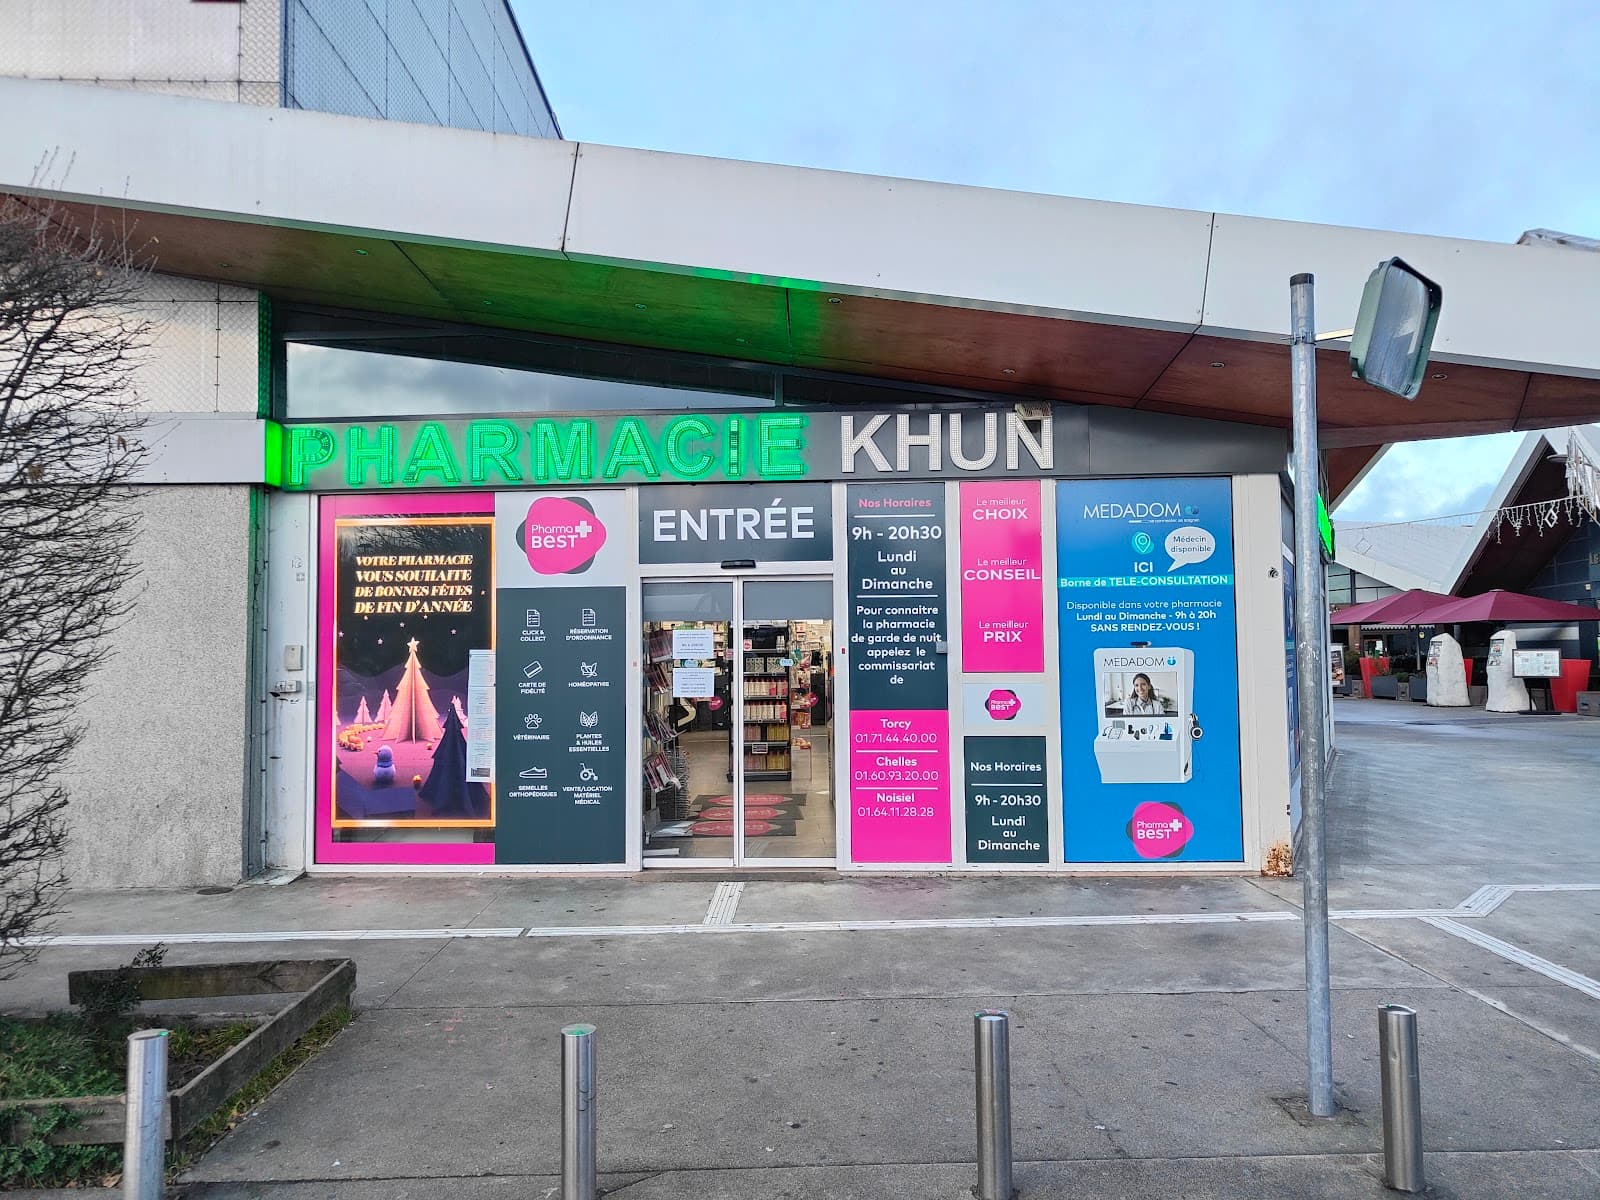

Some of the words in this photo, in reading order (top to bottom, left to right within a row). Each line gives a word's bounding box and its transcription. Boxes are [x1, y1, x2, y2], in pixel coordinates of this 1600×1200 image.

[287, 414, 806, 487] PHARMACIE
[840, 412, 1055, 474] KHUN
[858, 498, 880, 508] Nos
[884, 498, 932, 508] Horaires
[976, 497, 986, 506] Le
[988, 497, 1025, 505] meilleur
[972, 508, 1029, 521] CHOIX
[1083, 502, 1181, 519] MEDADOM
[652, 498, 815, 542] ENTRÉE
[531, 524, 574, 535] Pharma
[852, 526, 872, 540] 9h
[888, 525, 942, 540] 20h30
[1173, 535, 1207, 543] Médecin
[1170, 544, 1212, 554] disponible
[355, 555, 398, 567] VOTRE
[398, 554, 474, 566] PHARMACIE
[877, 550, 917, 562] Lundi
[977, 558, 988, 566] Le
[990, 558, 1026, 566] meilleur
[1134, 561, 1153, 573] ICI
[355, 570, 395, 583] VOUS
[395, 569, 472, 582] SOUHAITE
[890, 567, 906, 576] au
[964, 569, 1041, 581] CONSEIL
[862, 578, 933, 590] Dimanche
[1060, 577, 1092, 587] Borne
[1094, 577, 1107, 587] de
[1109, 575, 1228, 586] TELE-CONSULTATION
[354, 586, 374, 598] DE
[375, 585, 430, 597] BONNES
[431, 583, 473, 596] FÊTES
[354, 601, 375, 614] DE
[376, 601, 402, 614] FIN
[404, 598, 474, 613] D'ANNÉE
[856, 606, 883, 615] Pour
[1066, 601, 1116, 611] Disponible
[1118, 600, 1141, 609] dans
[1144, 601, 1169, 609] votre
[1171, 599, 1222, 610] pharmacie
[1076, 612, 1102, 621] Lundi
[1119, 611, 1166, 620] Dimanche
[1175, 611, 1187, 619] 9h
[1197, 611, 1217, 619] 20h
[863, 619, 873, 629] la
[876, 619, 936, 631] pharmacie
[978, 620, 990, 629] Le
[992, 620, 1028, 629] meilleur
[1090, 624, 1119, 632] SANS
[1120, 622, 1195, 632] RENDEZ-VOUS
[851, 633, 864, 642] de
[867, 633, 900, 645] garde
[903, 632, 917, 642] de
[920, 632, 942, 642] nuit
[983, 630, 1023, 643] PRIX
[867, 647, 911, 659] appelez
[916, 647, 926, 656] le
[858, 660, 936, 671] commissariat
[1103, 656, 1165, 667] MEDADOM
[890, 675, 904, 684] de
[880, 718, 912, 730] Torcy
[855, 733, 937, 744] 01.71.44.40.00
[876, 756, 918, 767] Chelles
[970, 762, 992, 771] Nos
[994, 761, 1042, 771] Horaires
[854, 770, 939, 781] 01.60.93.20.00
[509, 790, 557, 798] ORTHOPÉDIQUES
[876, 792, 915, 803] Noisiel
[974, 795, 991, 806] 9h
[1000, 795, 1041, 806] 20h30
[857, 806, 934, 817] 01.64.11.28.28
[991, 815, 1026, 826] Lundi
[1136, 821, 1169, 829] Pharma
[1002, 830, 1017, 838] au
[978, 839, 1041, 850] Dimanche
